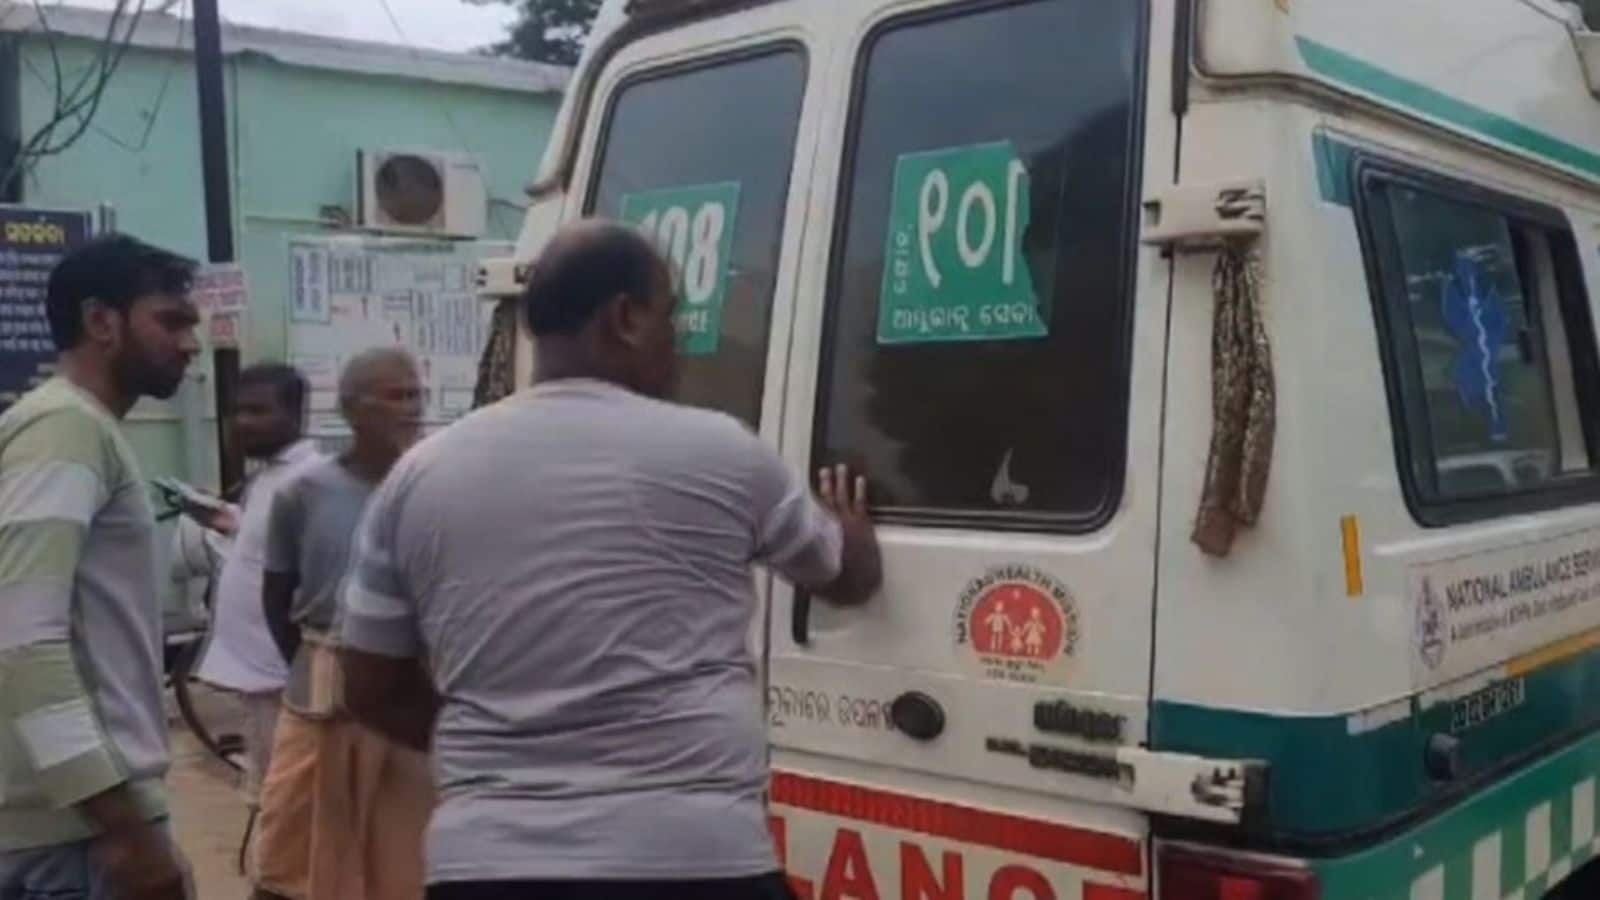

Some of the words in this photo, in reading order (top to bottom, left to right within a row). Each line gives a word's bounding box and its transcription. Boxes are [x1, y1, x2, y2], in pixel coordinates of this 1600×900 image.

[956, 574, 995, 645] NATIONAL
[996, 562, 1053, 588] HEALTH
[1446, 575, 1508, 611] NATIONAL
